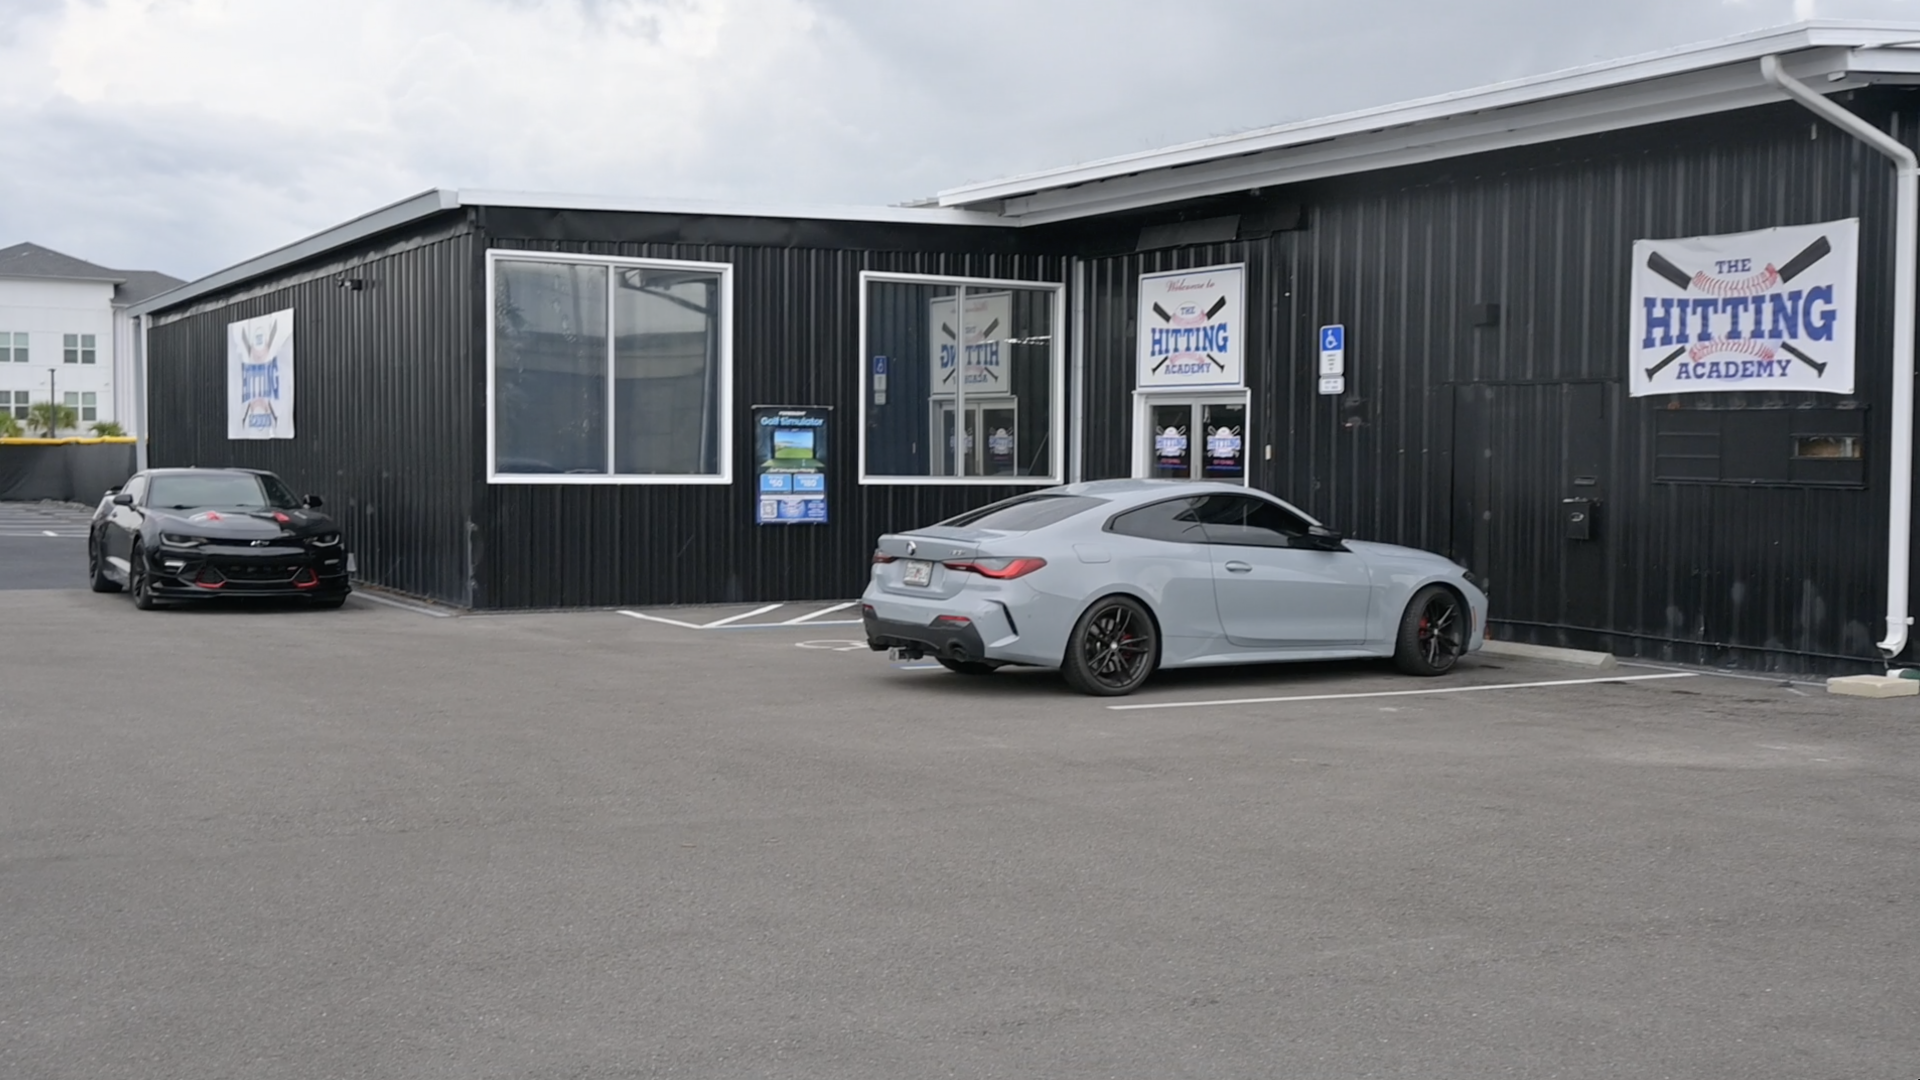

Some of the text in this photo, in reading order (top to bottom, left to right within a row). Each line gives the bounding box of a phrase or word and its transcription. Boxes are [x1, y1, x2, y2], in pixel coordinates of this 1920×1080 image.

[1715, 258, 1752, 275] THE
[1180, 306, 1196, 315] THE
[1642, 284, 1837, 349] HITTING
[1150, 322, 1229, 357] HITTING
[1164, 363, 1212, 375] ACADEMY
[1675, 359, 1792, 380] ACADEMY
